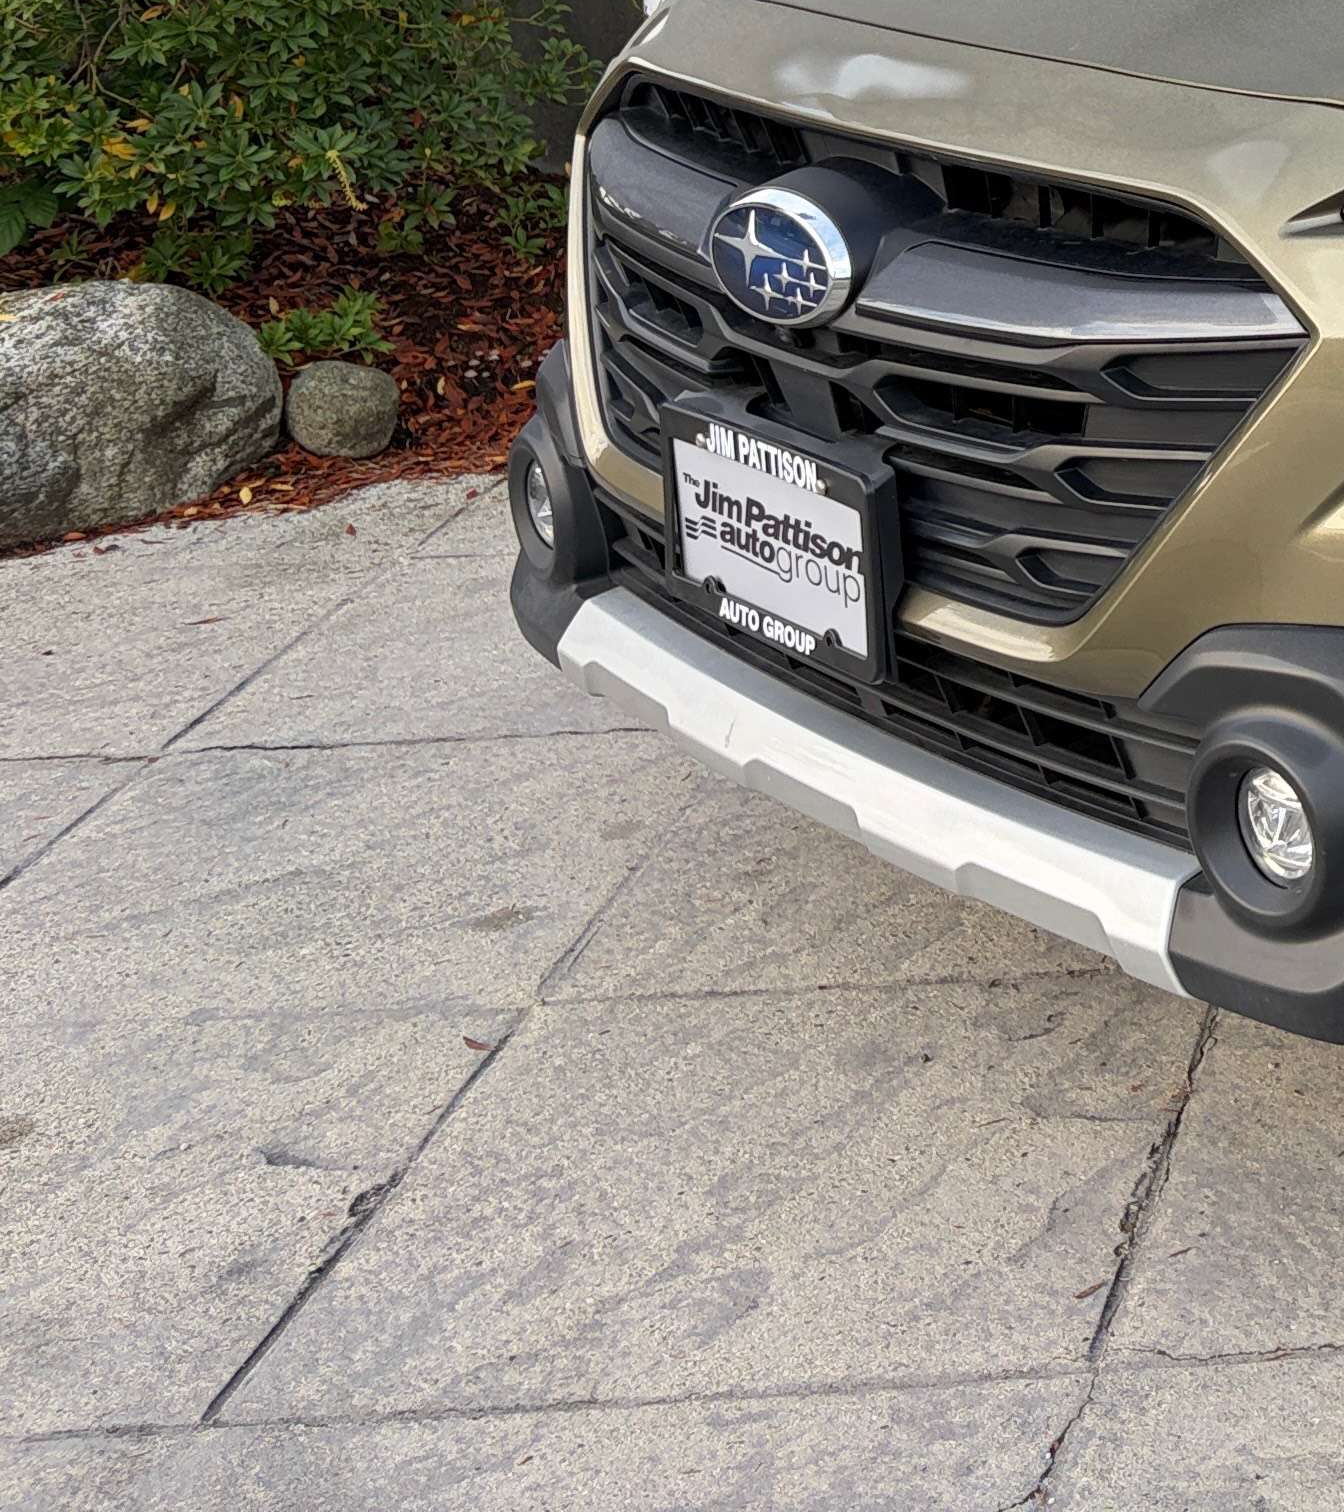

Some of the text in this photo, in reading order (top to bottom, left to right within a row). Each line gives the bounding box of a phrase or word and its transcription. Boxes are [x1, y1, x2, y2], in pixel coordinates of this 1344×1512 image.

[683, 472, 700, 487] The
[706, 423, 817, 493] JIM PATTISON
[719, 597, 816, 655] AUTO GROUP
